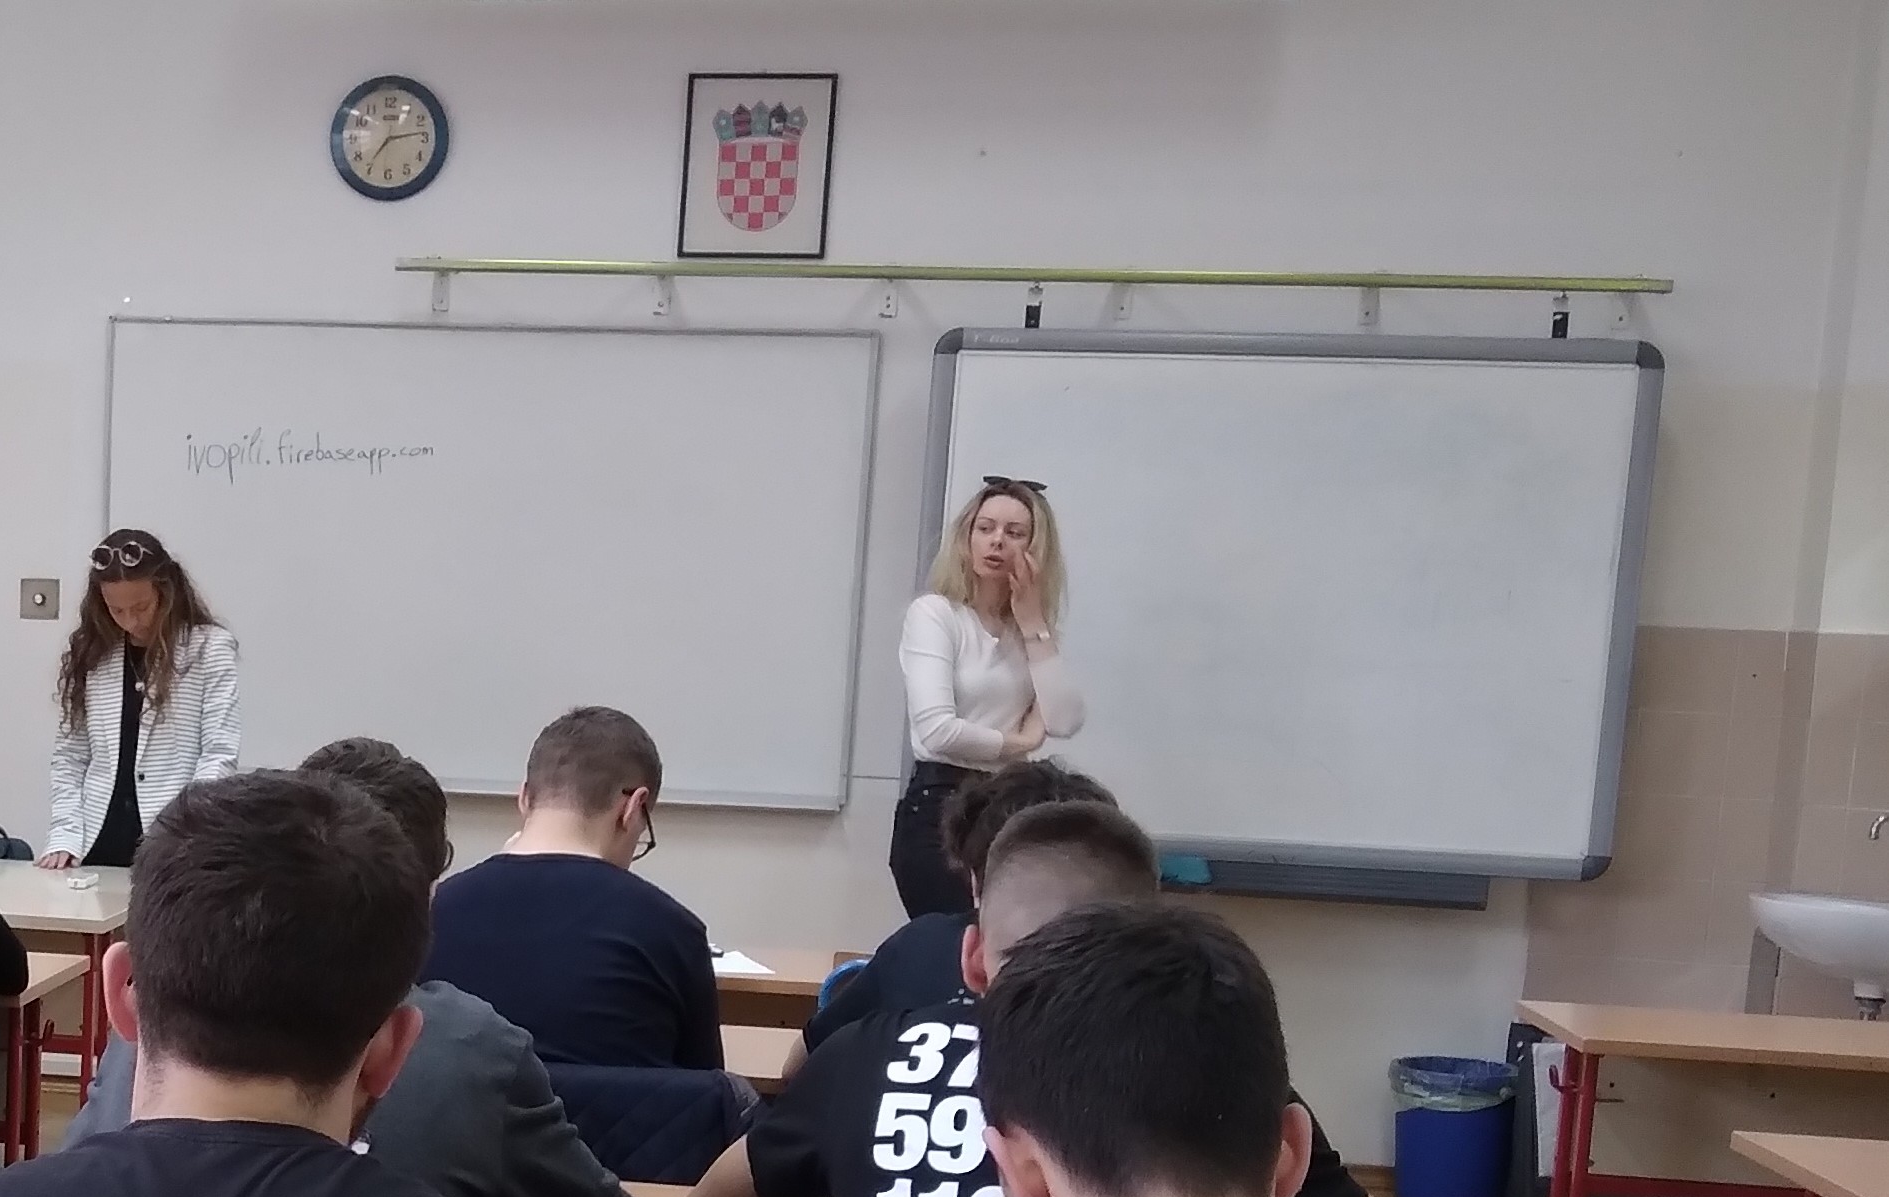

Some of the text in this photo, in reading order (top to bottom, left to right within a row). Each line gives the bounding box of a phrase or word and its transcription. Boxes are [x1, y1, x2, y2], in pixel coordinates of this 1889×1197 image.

[385, 97, 397, 108] 12
[355, 116, 368, 127] 10
[416, 115, 425, 127] 2
[421, 131, 429, 143] 3
[353, 150, 363, 162] 8
[366, 163, 374, 175] 7
[383, 169, 393, 180] 6
[403, 163, 411, 176] 5
[887, 1022, 981, 1088] 37
[873, 1092, 988, 1174] 59
